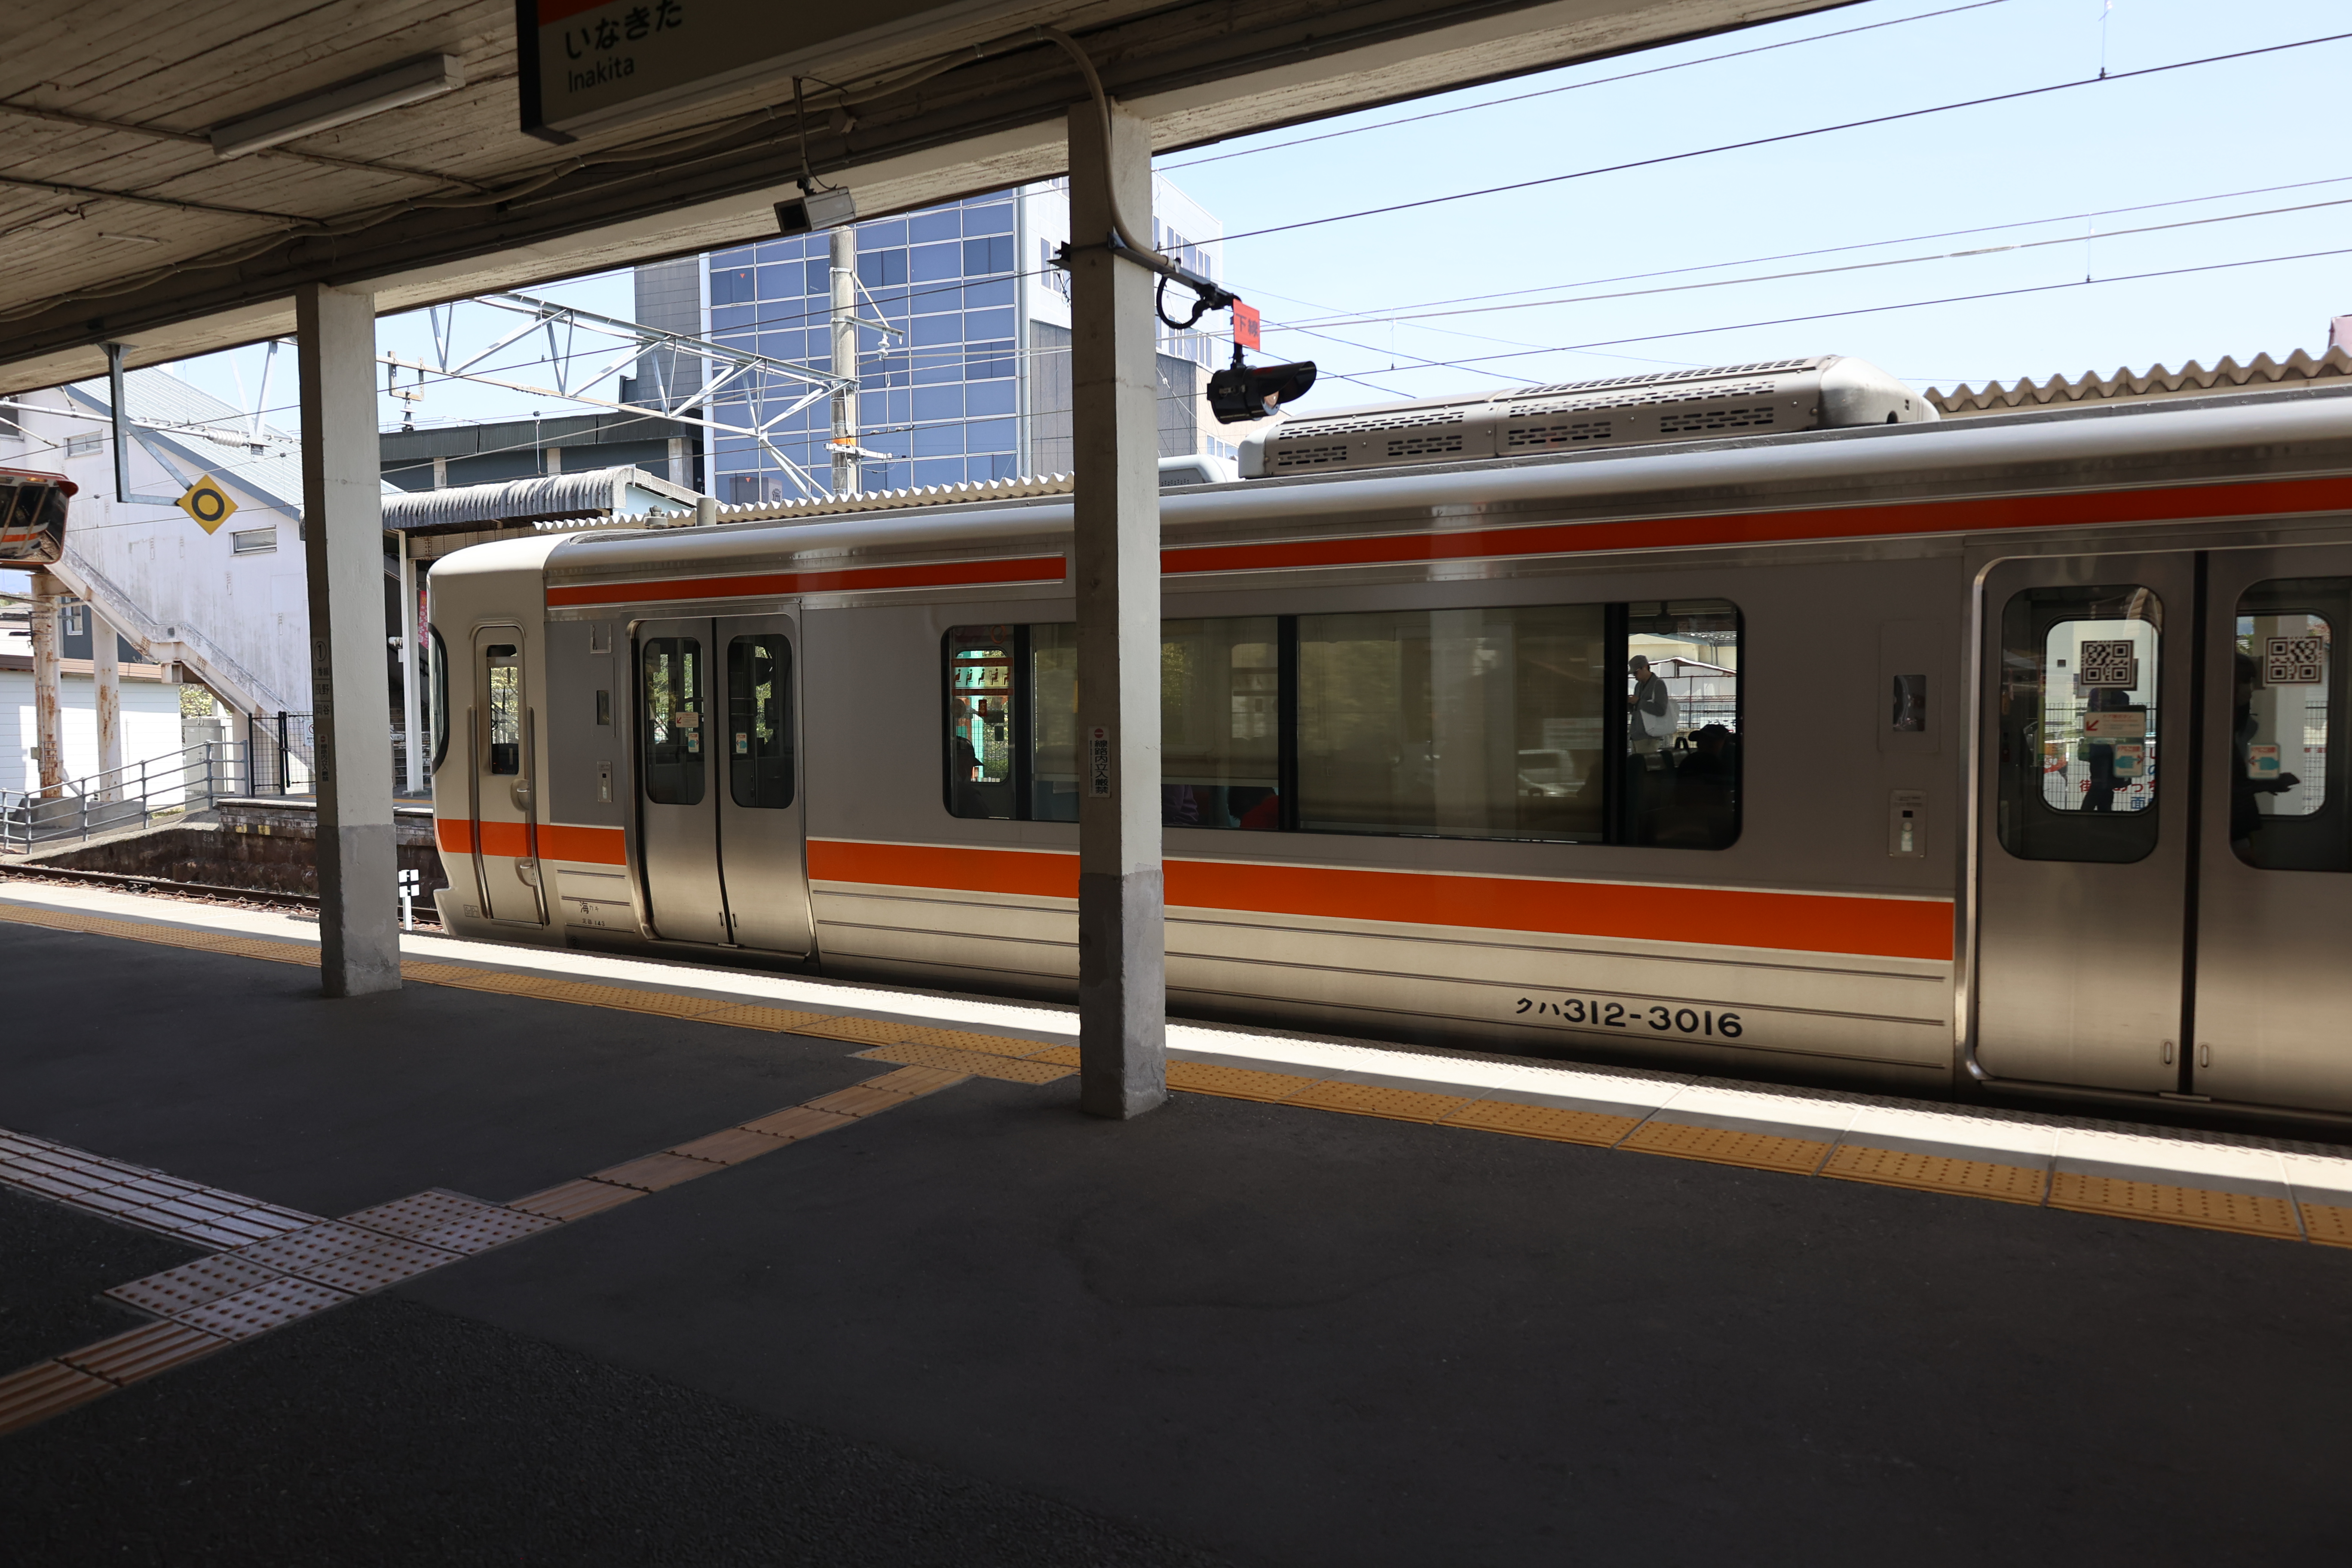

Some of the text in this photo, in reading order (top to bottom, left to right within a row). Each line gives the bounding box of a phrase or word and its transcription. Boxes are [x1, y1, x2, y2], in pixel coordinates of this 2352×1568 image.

[565, 0, 682, 59] いなきた
[568, 57, 634, 93] Inakita
[315, 684, 330, 695] 辰野
[315, 704, 330, 715] 岡谷
[1094, 740, 1109, 794] 線路内立入厳禁
[1516, 997, 1743, 1038] クハ312-3016
